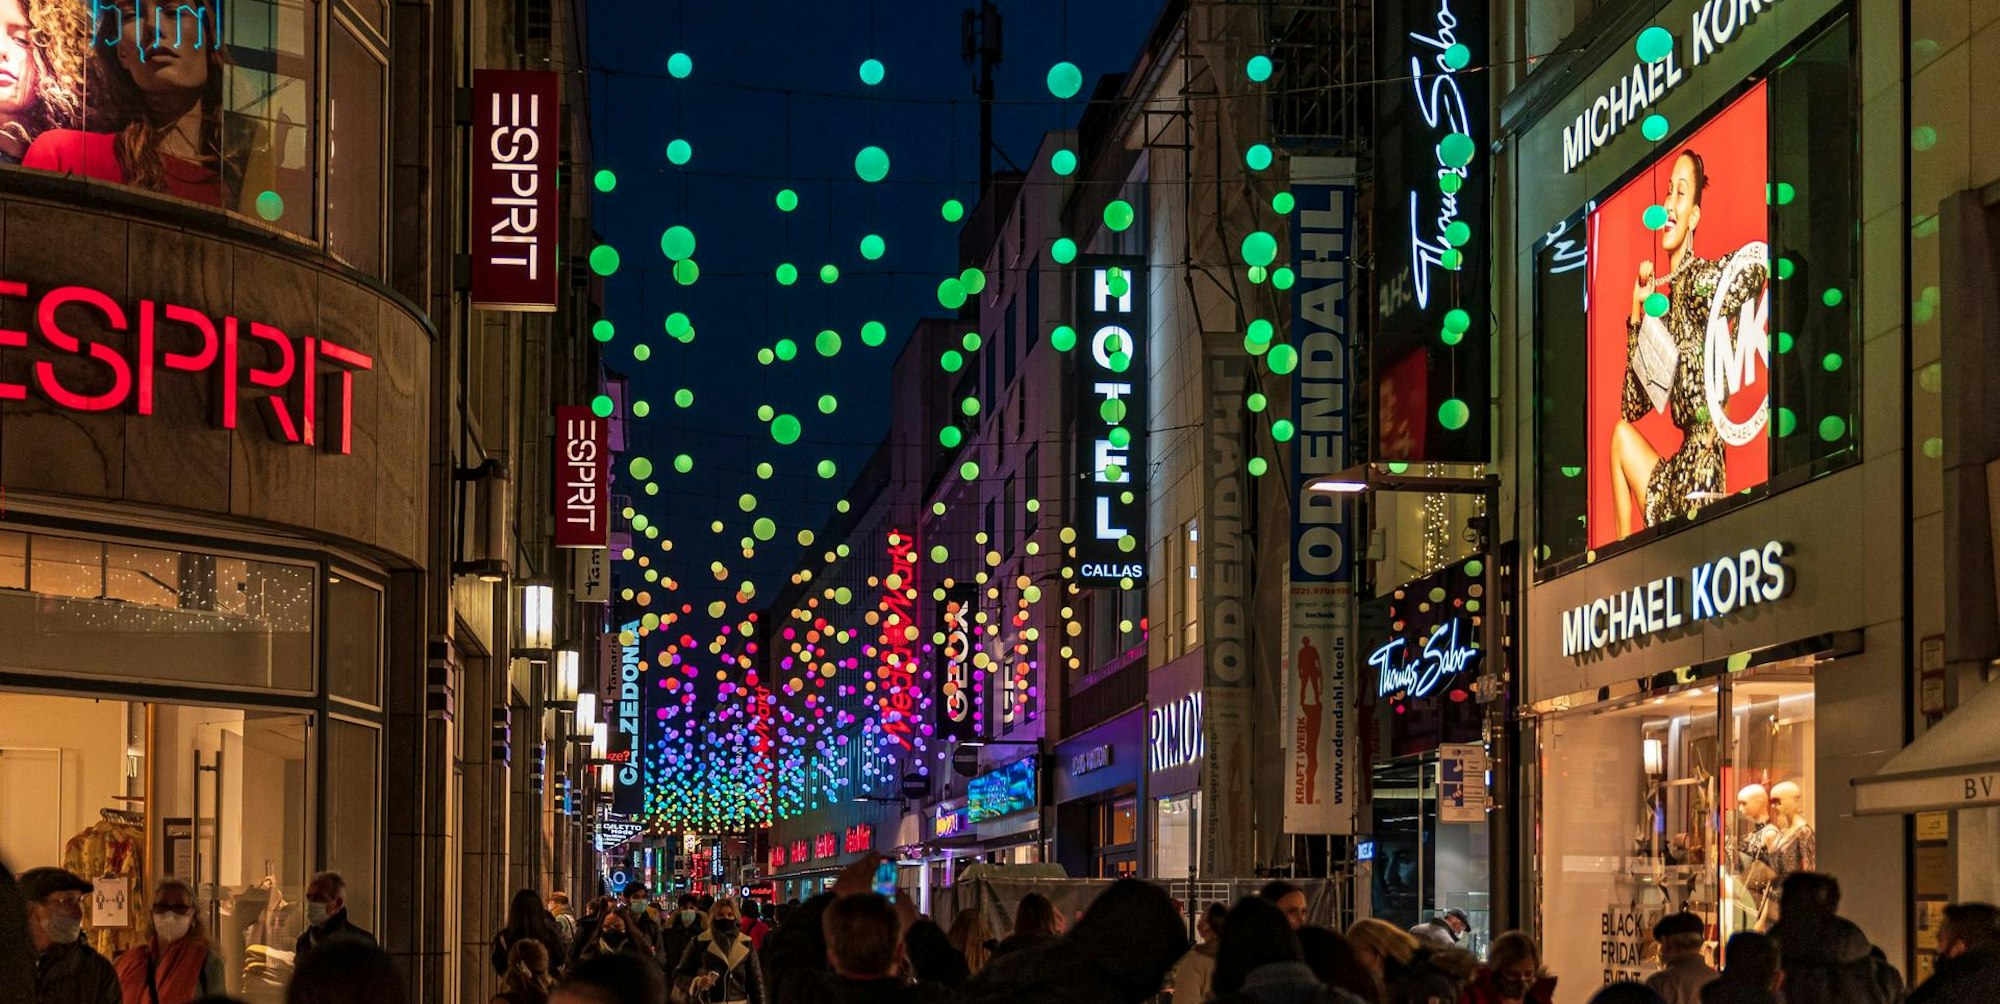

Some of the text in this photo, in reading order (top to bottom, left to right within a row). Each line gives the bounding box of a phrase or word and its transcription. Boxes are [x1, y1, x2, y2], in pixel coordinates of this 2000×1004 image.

[1563, 0, 1786, 174] MICHAEL KO
[490, 93, 540, 281] ESPRIT
[1091, 269, 1134, 540] HOTEL
[1297, 191, 1345, 576] ODENDAHL
[567, 419, 596, 532] ESPRIT
[1081, 563, 1143, 579] CALLAS
[1562, 540, 1786, 658] MICHAEL KORS
[605, 635, 618, 696] Tamaris
[946, 600, 970, 723] GEOX
[1367, 617, 1476, 697] Thomas Sabo
[1295, 716, 1306, 805] KRAFT WERK
[1332, 636, 1345, 806] www.odendahl.koeln
[1601, 913, 1643, 937] BLACK
[1601, 940, 1644, 966] FRIDAY
